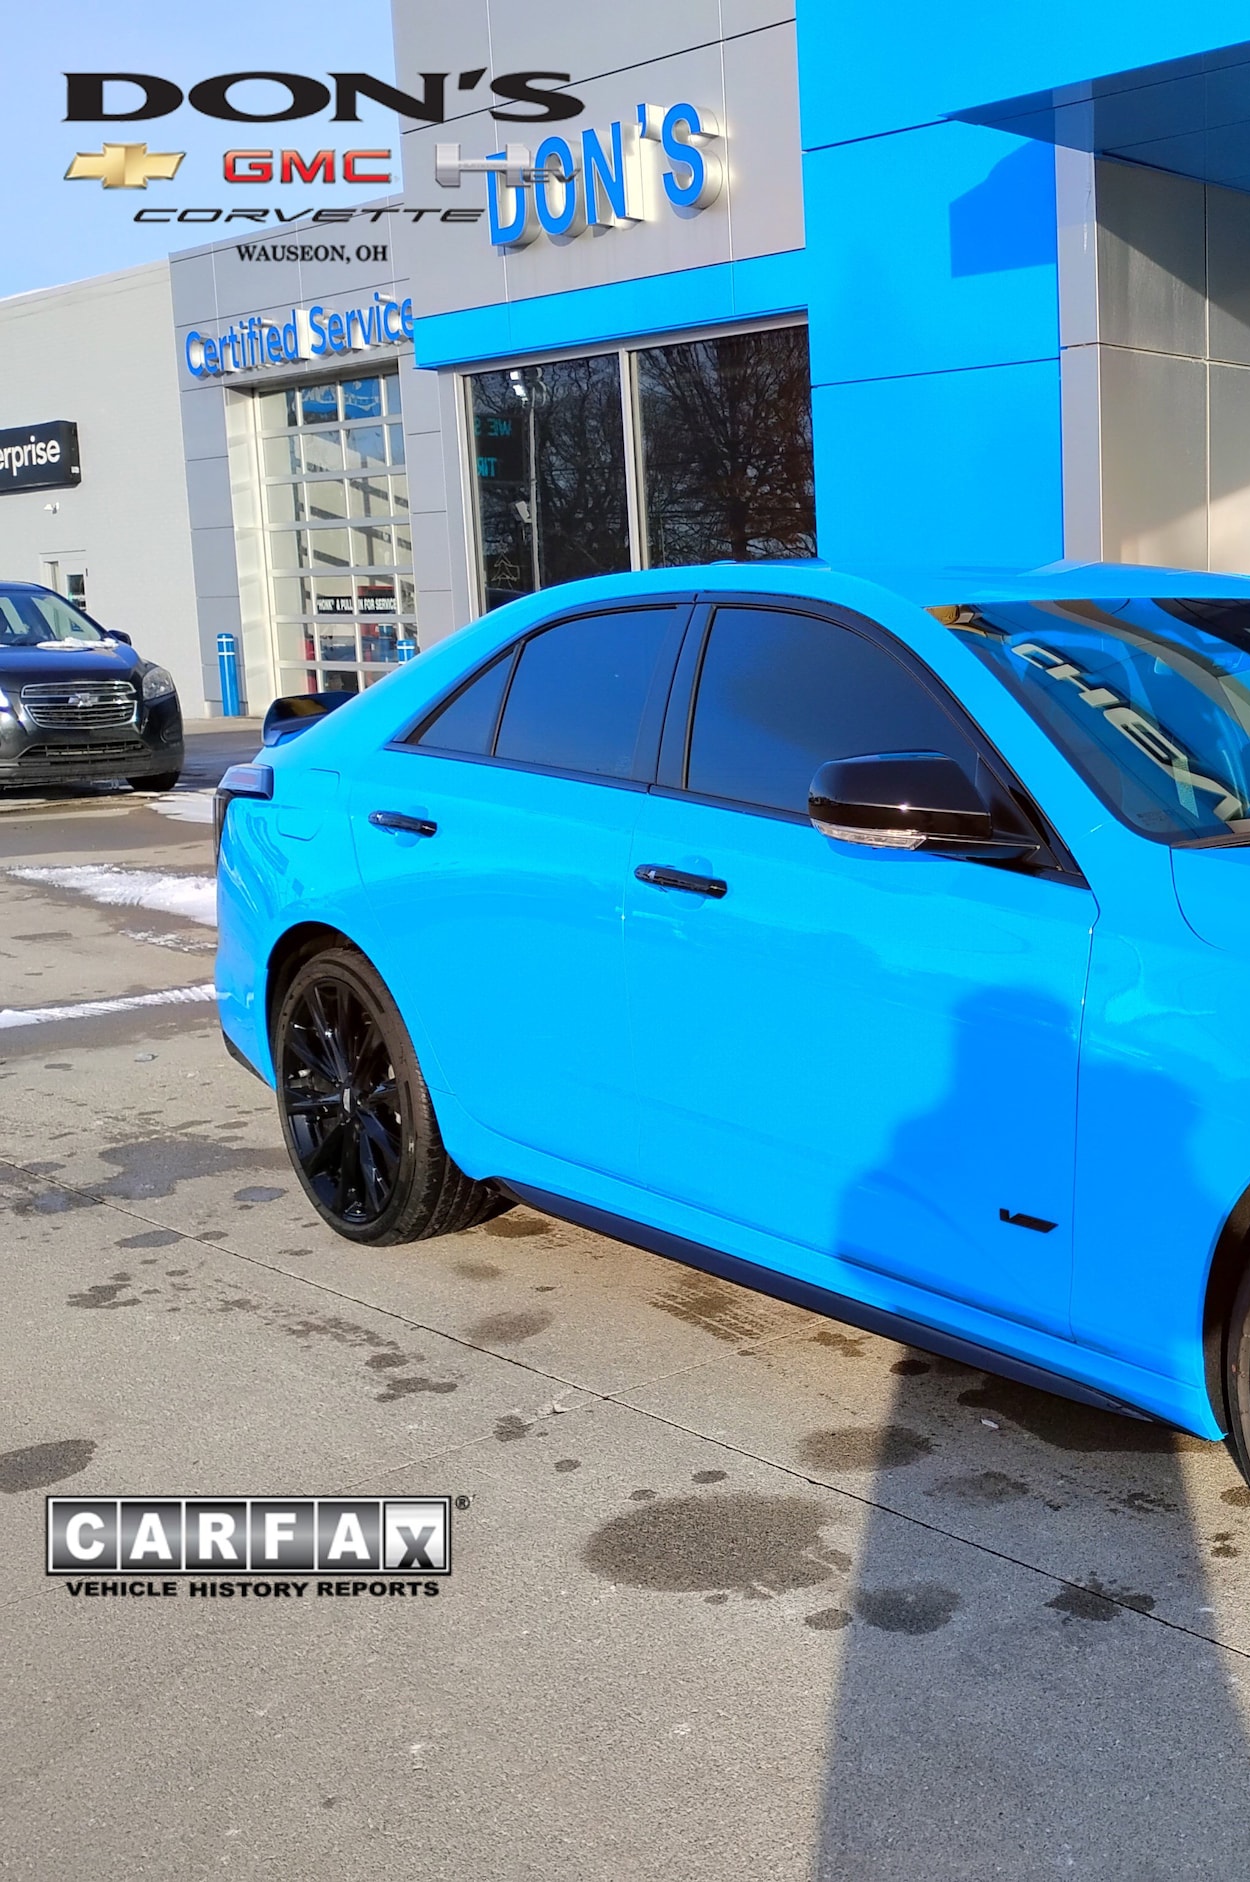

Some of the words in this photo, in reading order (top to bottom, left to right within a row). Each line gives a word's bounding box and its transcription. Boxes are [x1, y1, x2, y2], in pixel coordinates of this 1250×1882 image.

[486, 103, 706, 247] DON'S
[185, 309, 299, 377] Certified
[308, 291, 414, 355] Service
